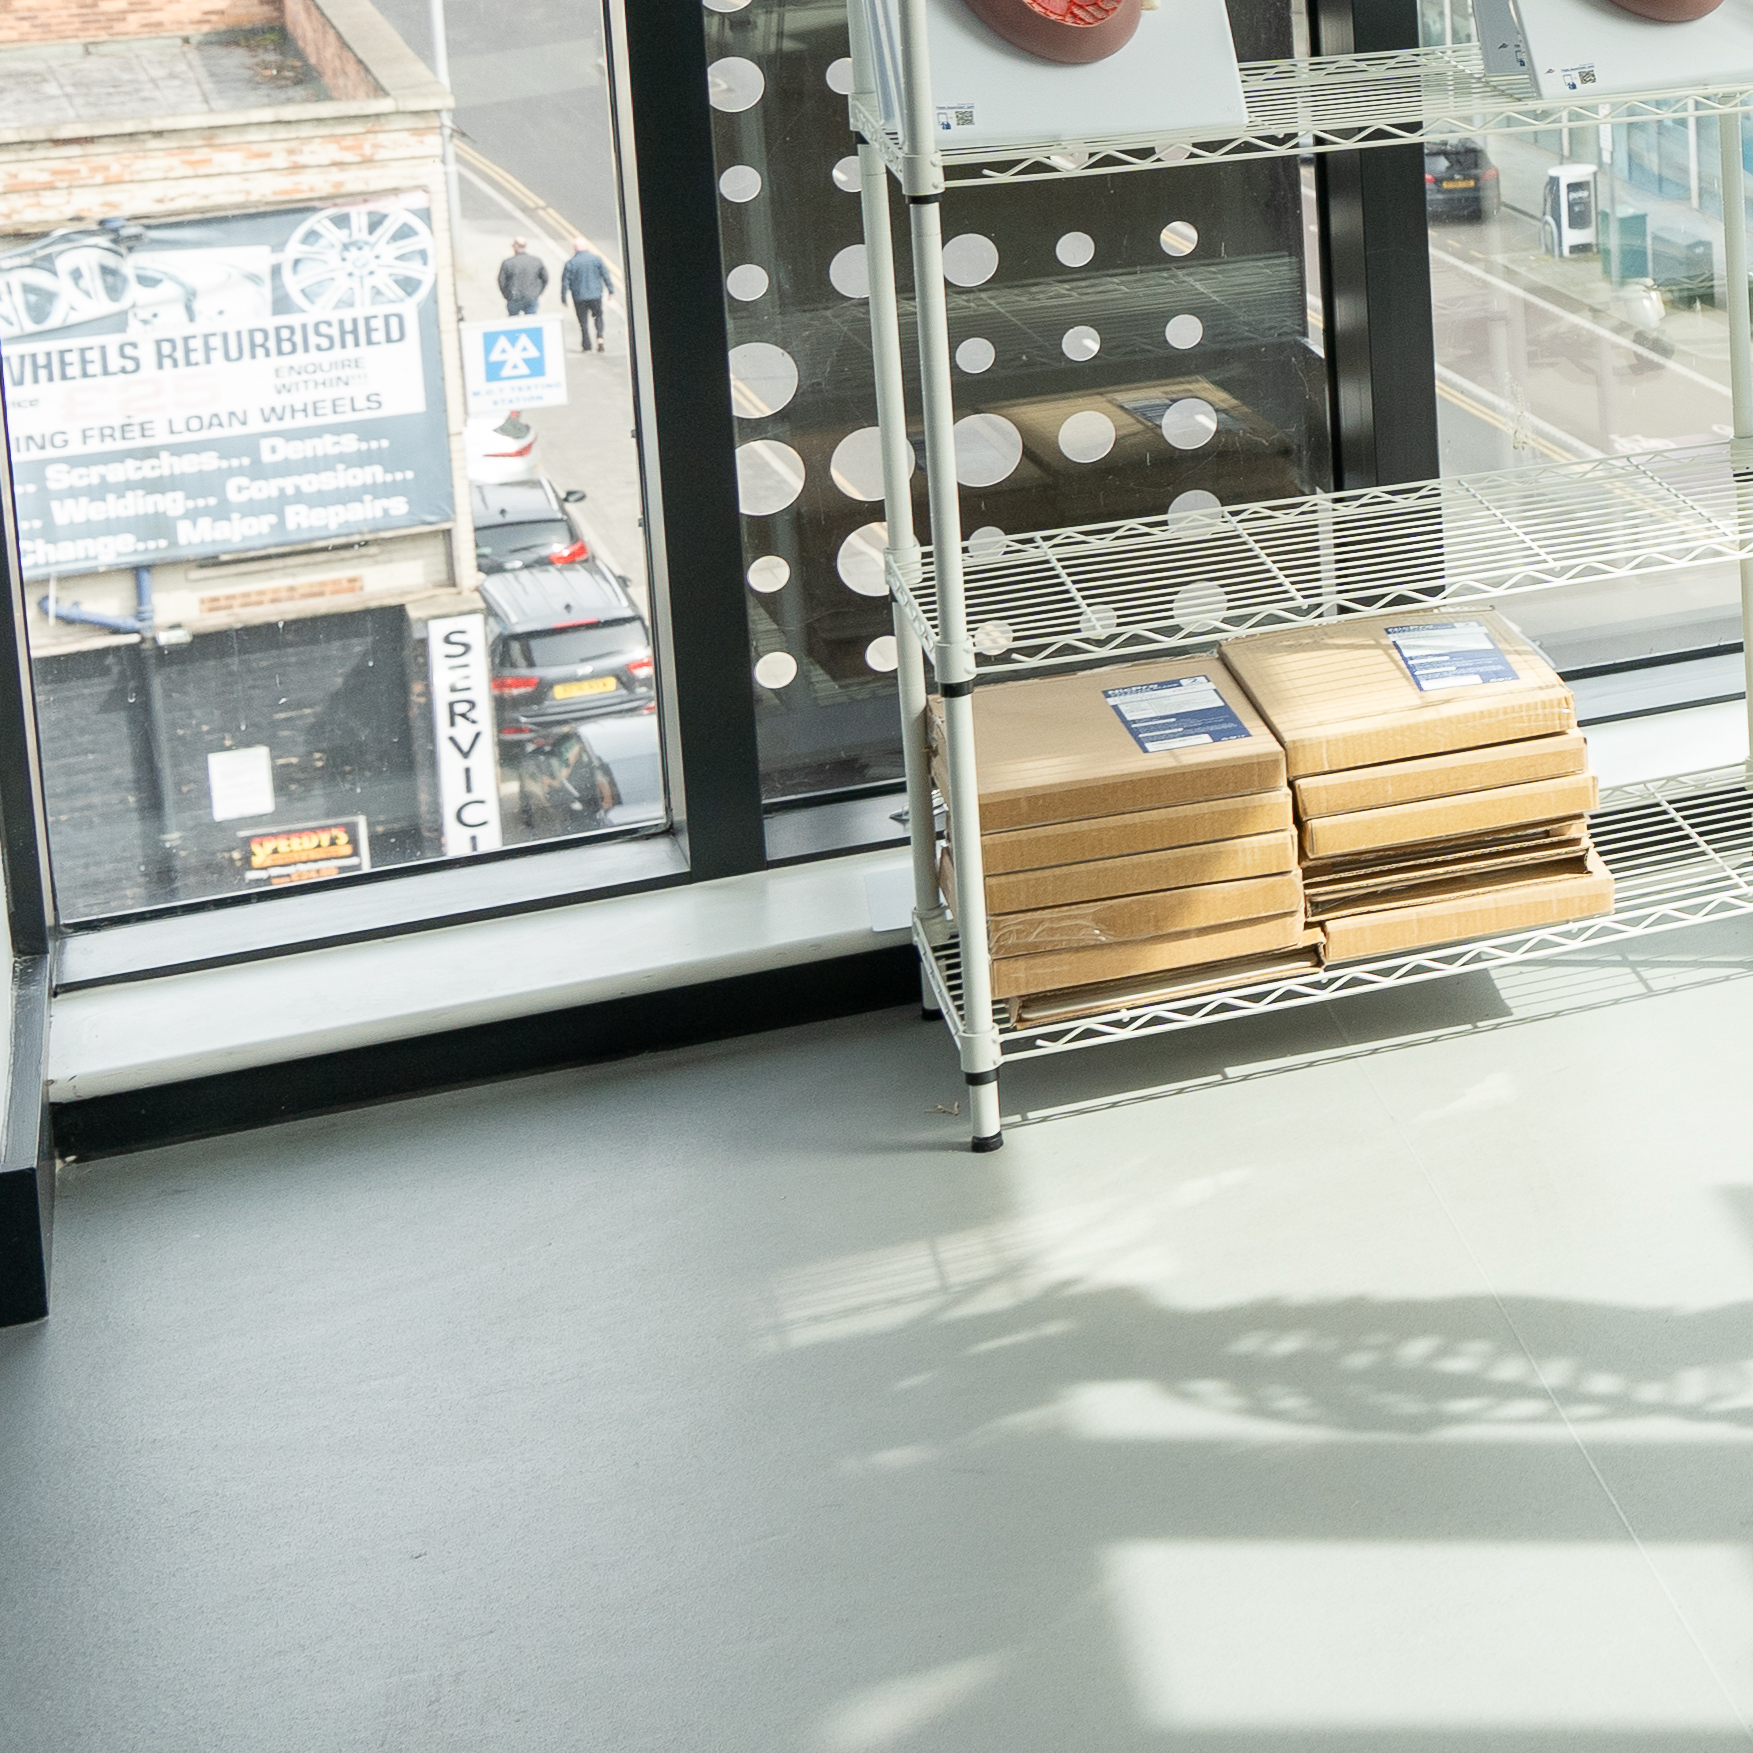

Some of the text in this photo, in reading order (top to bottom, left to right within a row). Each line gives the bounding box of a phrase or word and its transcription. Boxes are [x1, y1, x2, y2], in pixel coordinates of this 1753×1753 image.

[154, 312, 406, 371] REFURBISHED
[275, 356, 365, 379] ENQUIRE
[82, 420, 156, 446] FREE
[169, 410, 248, 435] LOAN
[260, 393, 382, 423] WHEELS
[176, 512, 278, 547] Major
[283, 494, 410, 531] Repairs
